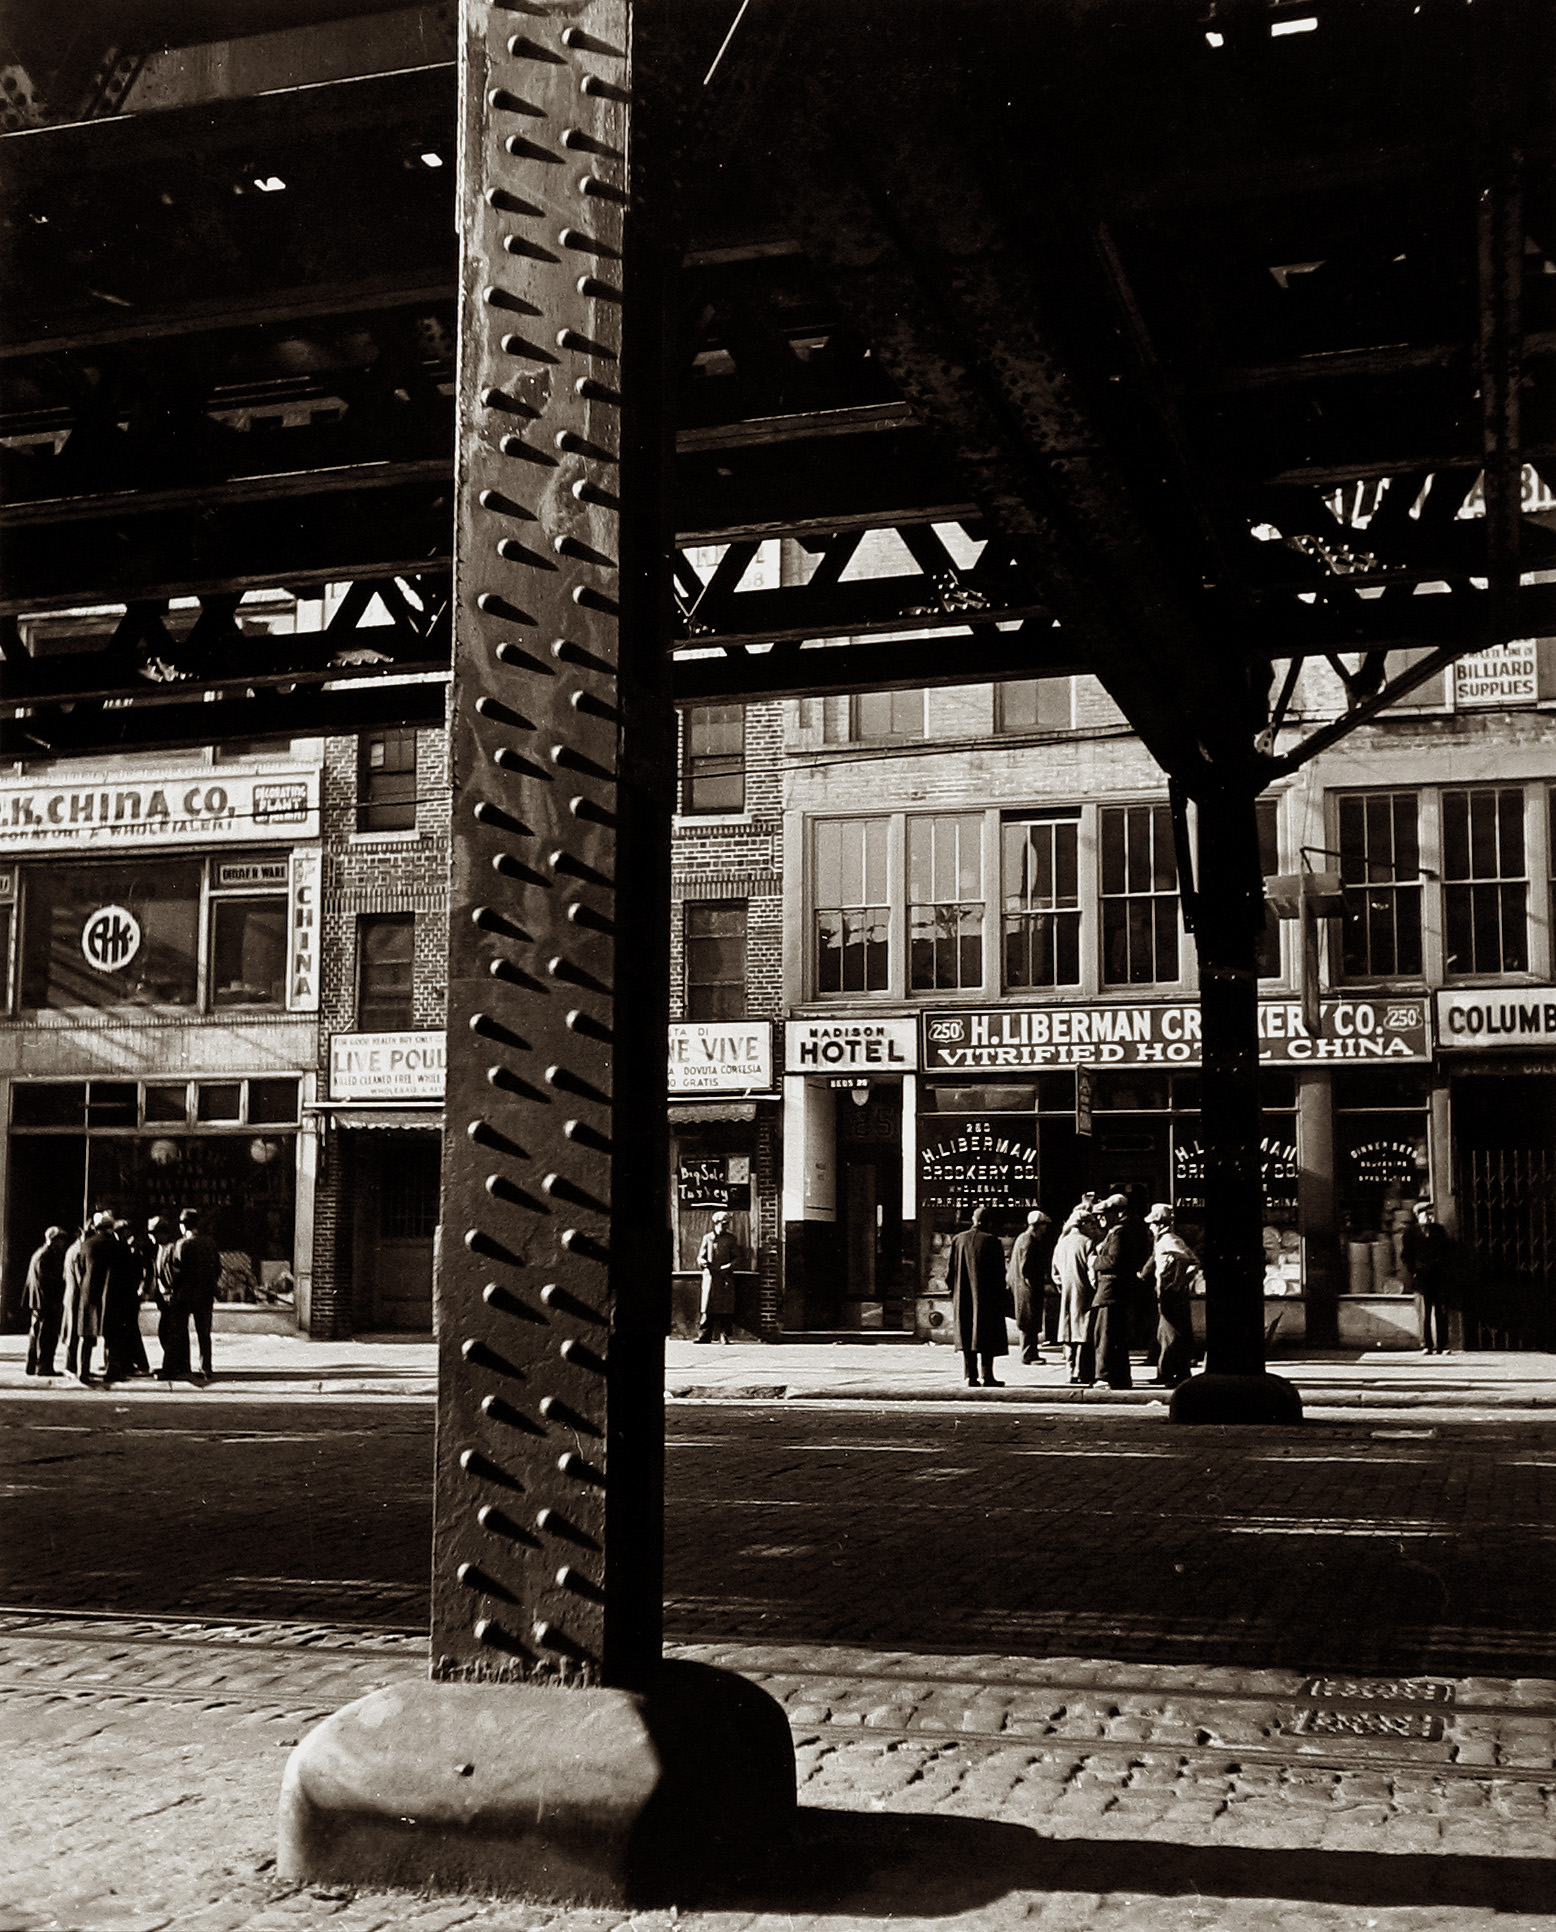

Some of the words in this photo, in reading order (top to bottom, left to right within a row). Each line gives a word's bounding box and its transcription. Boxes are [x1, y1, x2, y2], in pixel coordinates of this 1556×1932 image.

[1457, 660, 1534, 680] BILLIARD
[1458, 680, 1534, 698] SUPPLIES
[258, 798, 302, 812] PLANT
[294, 886, 313, 997] CHINA
[1334, 1003, 1383, 1037] CO.
[1388, 1008, 1417, 1028] 250
[697, 1027, 709, 1036] DI
[809, 1026, 885, 1039] MADISON
[932, 1022, 960, 1040] 250
[701, 1036, 759, 1062] VIVE
[800, 1039, 905, 1064] HOTEL
[937, 1043, 1126, 1066] VITRIFIED
[1286, 1036, 1415, 1060] CHINA
[333, 1050, 381, 1073] LIVE
[683, 1065, 718, 1075] DOVUTA
[720, 1064, 762, 1075] CORTESIA
[682, 1078, 719, 1087] GRATIS
[922, 1164, 1009, 1180] CROCKERY
[1013, 1164, 1039, 1180] CO.
[1007, 1197, 1038, 1208] CHINA
